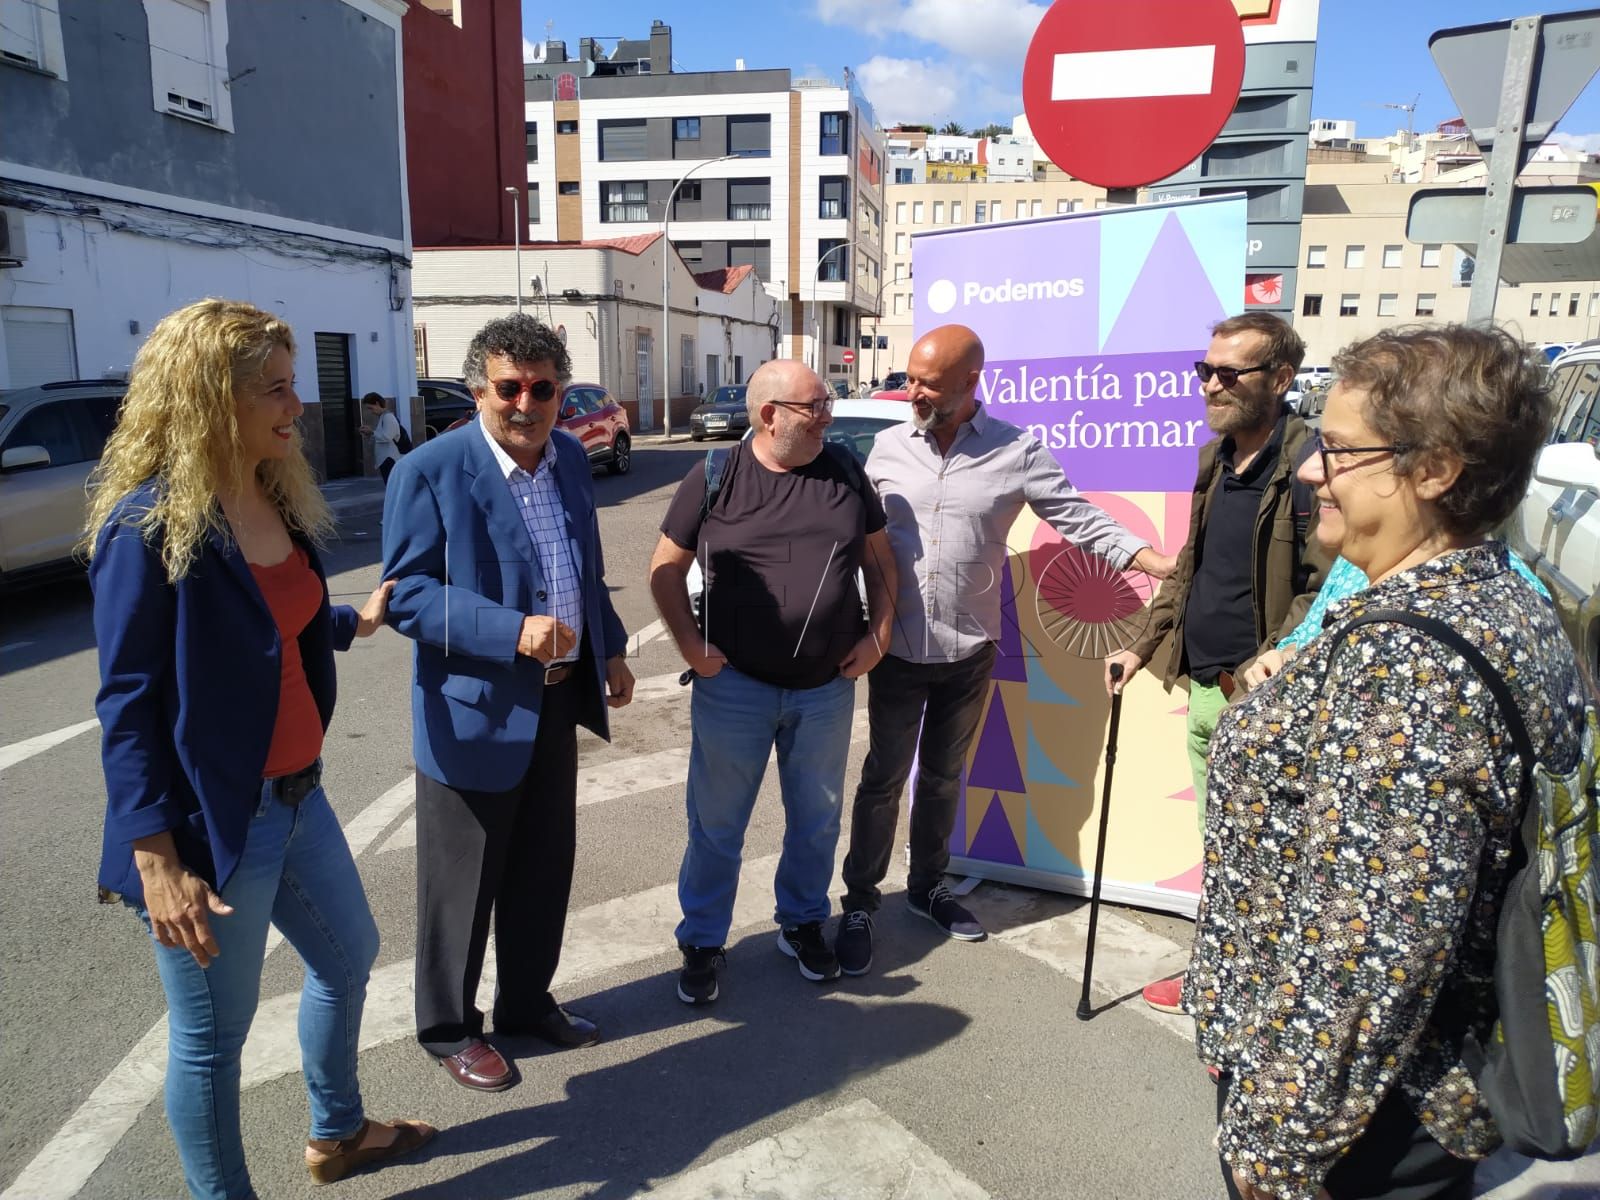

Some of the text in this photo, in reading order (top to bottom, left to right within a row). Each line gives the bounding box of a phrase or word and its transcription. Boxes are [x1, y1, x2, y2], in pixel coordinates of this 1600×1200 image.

[963, 276, 1084, 306] Podemos
[979, 362, 1123, 405] Valentía
[1013, 410, 1204, 449] nsformar
